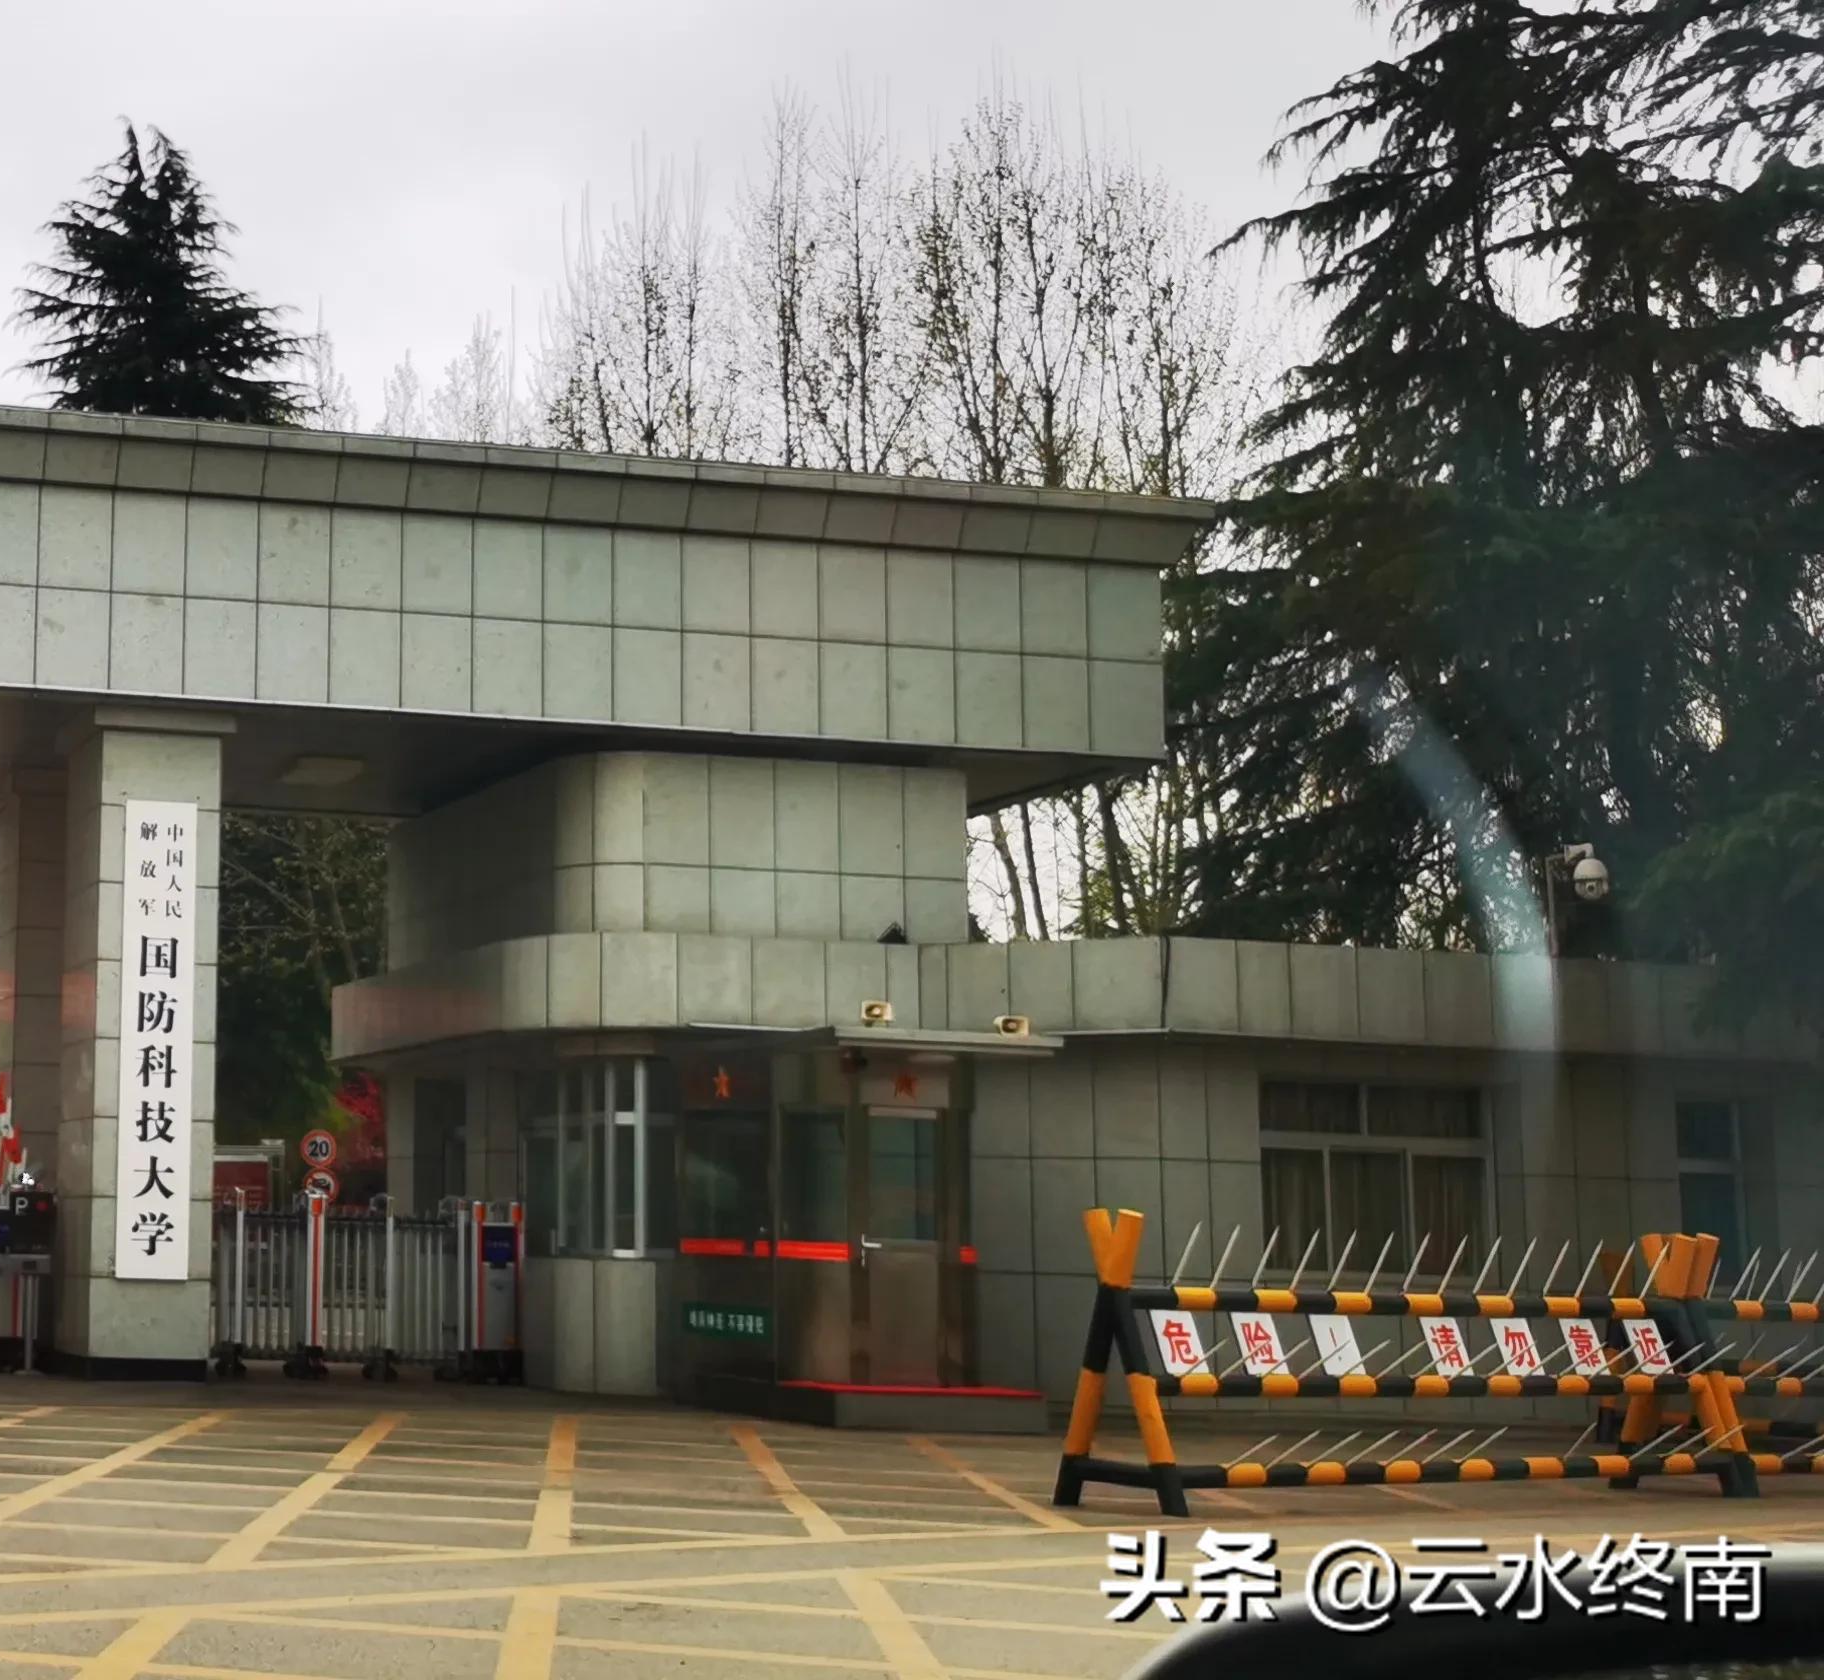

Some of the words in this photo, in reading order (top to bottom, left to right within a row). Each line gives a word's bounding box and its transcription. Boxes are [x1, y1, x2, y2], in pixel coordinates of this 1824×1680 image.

[138, 821, 158, 917] 解放军
[166, 823, 184, 919] 中国人民
[130, 934, 179, 1257] 国防科技大学
[307, 1140, 330, 1158] 20
